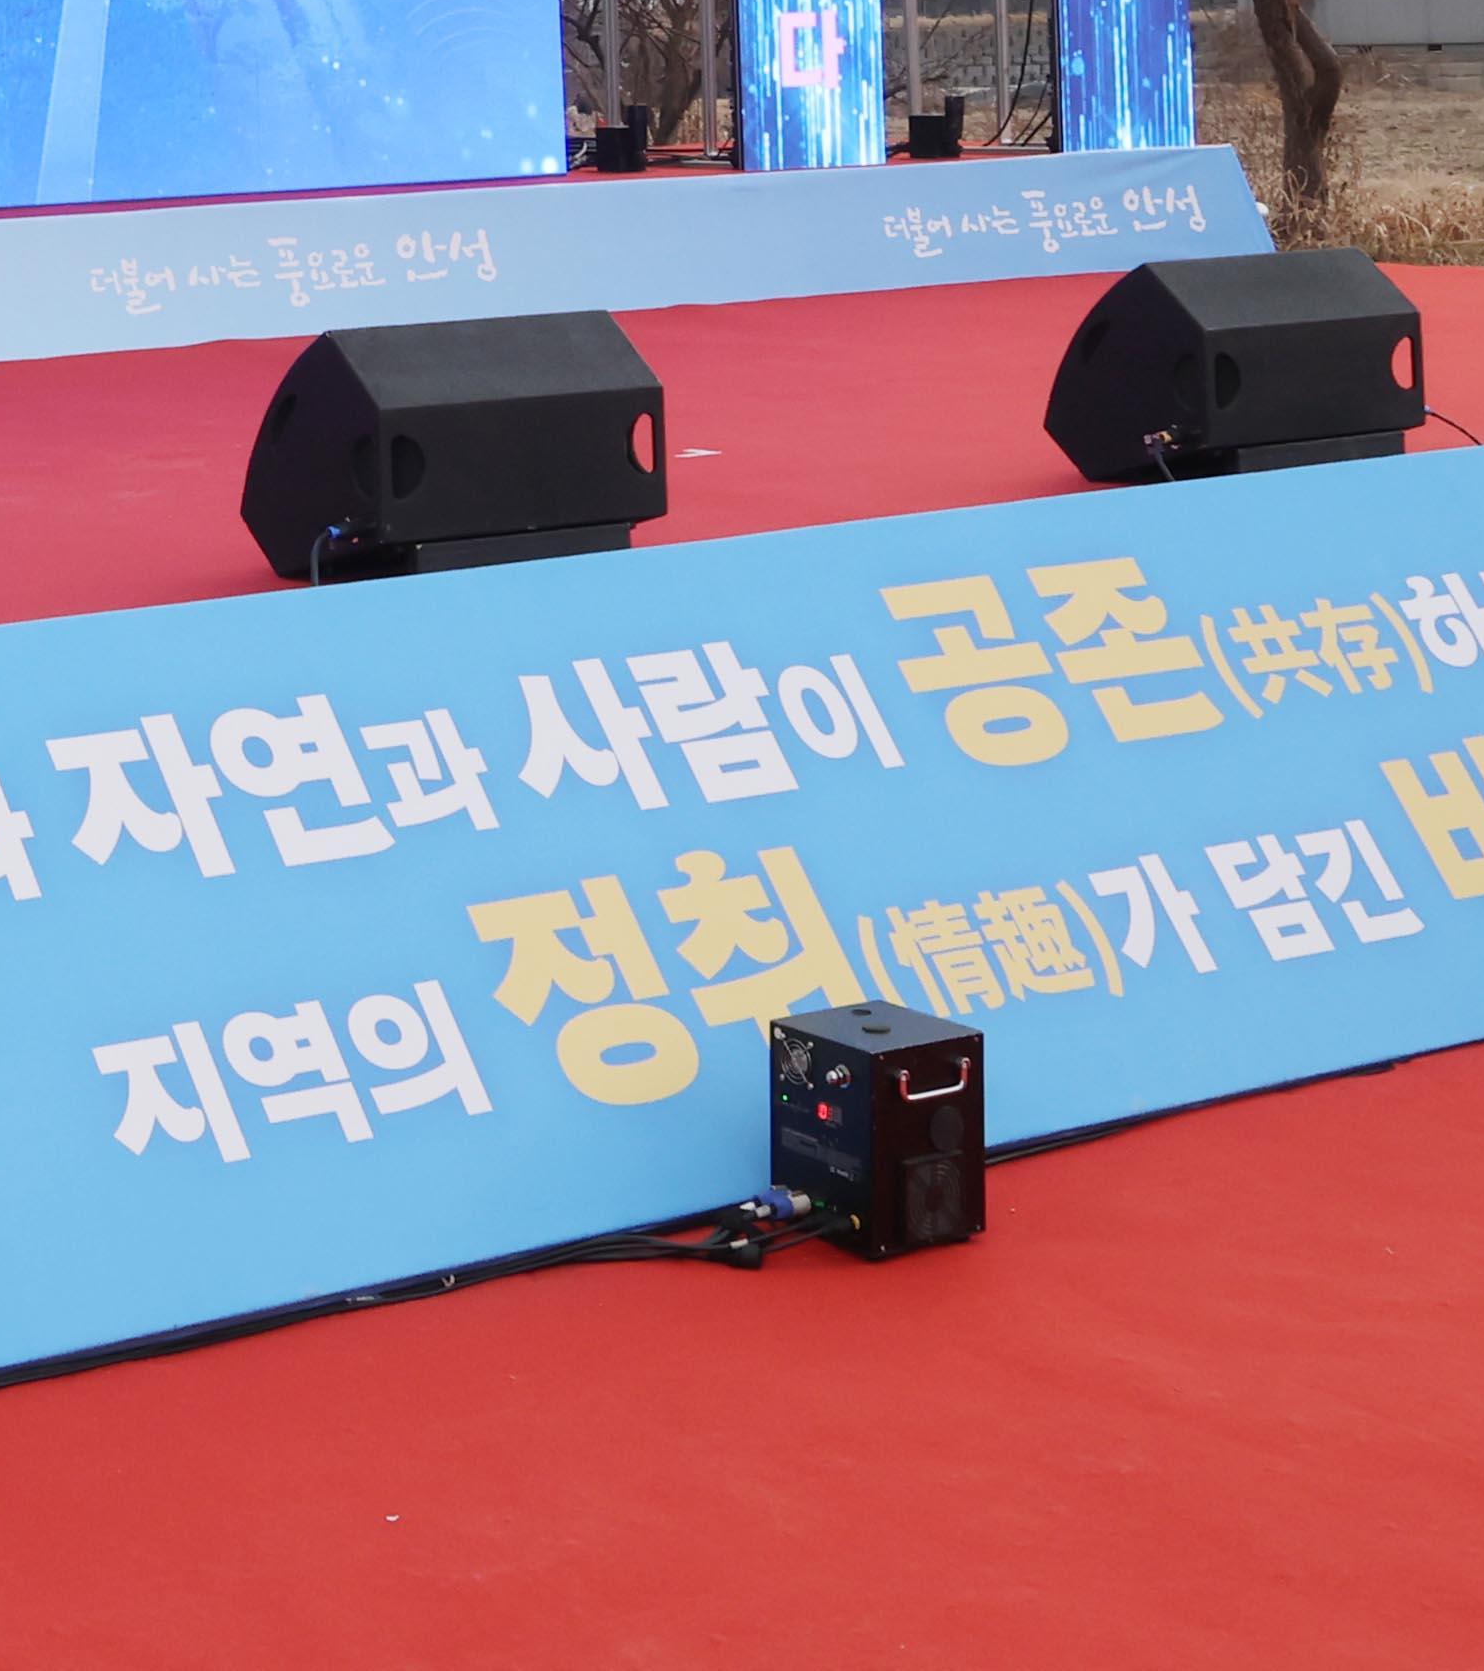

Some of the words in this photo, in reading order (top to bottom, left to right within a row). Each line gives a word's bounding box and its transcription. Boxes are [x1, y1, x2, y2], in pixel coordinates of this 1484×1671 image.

[188, 254, 263, 288] 사는
[267, 236, 388, 308] 풍요로운
[396, 229, 498, 282] 안성
[960, 204, 1020, 235] 사는
[1021, 189, 1119, 254] 풍요로운
[1123, 184, 1207, 232] 안성
[45, 693, 502, 880] 자연과
[516, 640, 905, 813] 사람이
[91, 978, 495, 1165] 지역의
[1219, 819, 1425, 962] 담긴
